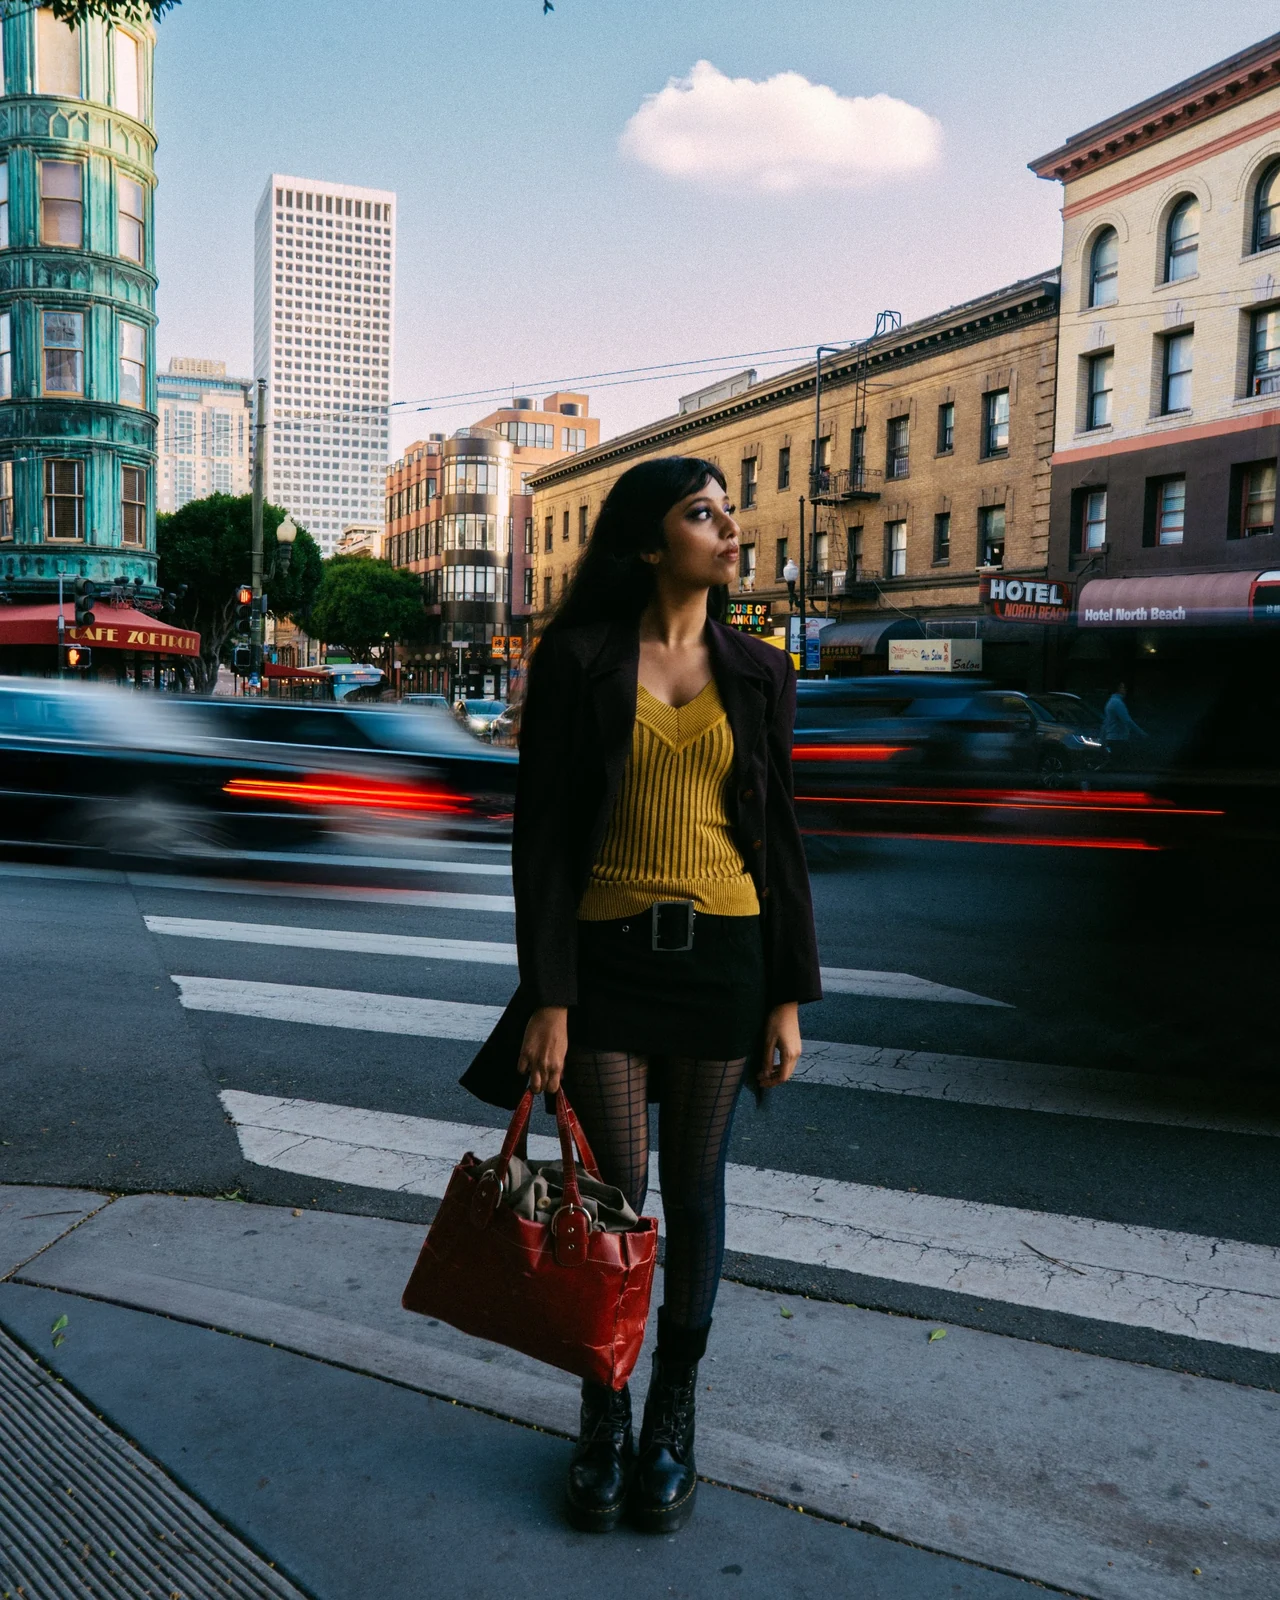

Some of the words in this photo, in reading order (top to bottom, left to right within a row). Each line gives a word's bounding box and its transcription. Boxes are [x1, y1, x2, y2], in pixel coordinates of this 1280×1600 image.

[990, 578, 1063, 605] HOTEL
[755, 604, 767, 615] OF
[1004, 602, 1037, 619] NORTH
[1038, 606, 1069, 621] BEACH
[1085, 607, 1113, 621] Hotel
[1115, 607, 1148, 621] North
[1150, 605, 1186, 621] Beach
[69, 627, 118, 642] CAFE
[127, 630, 196, 650] ZOETROPE
[952, 658, 980, 669] Salon
